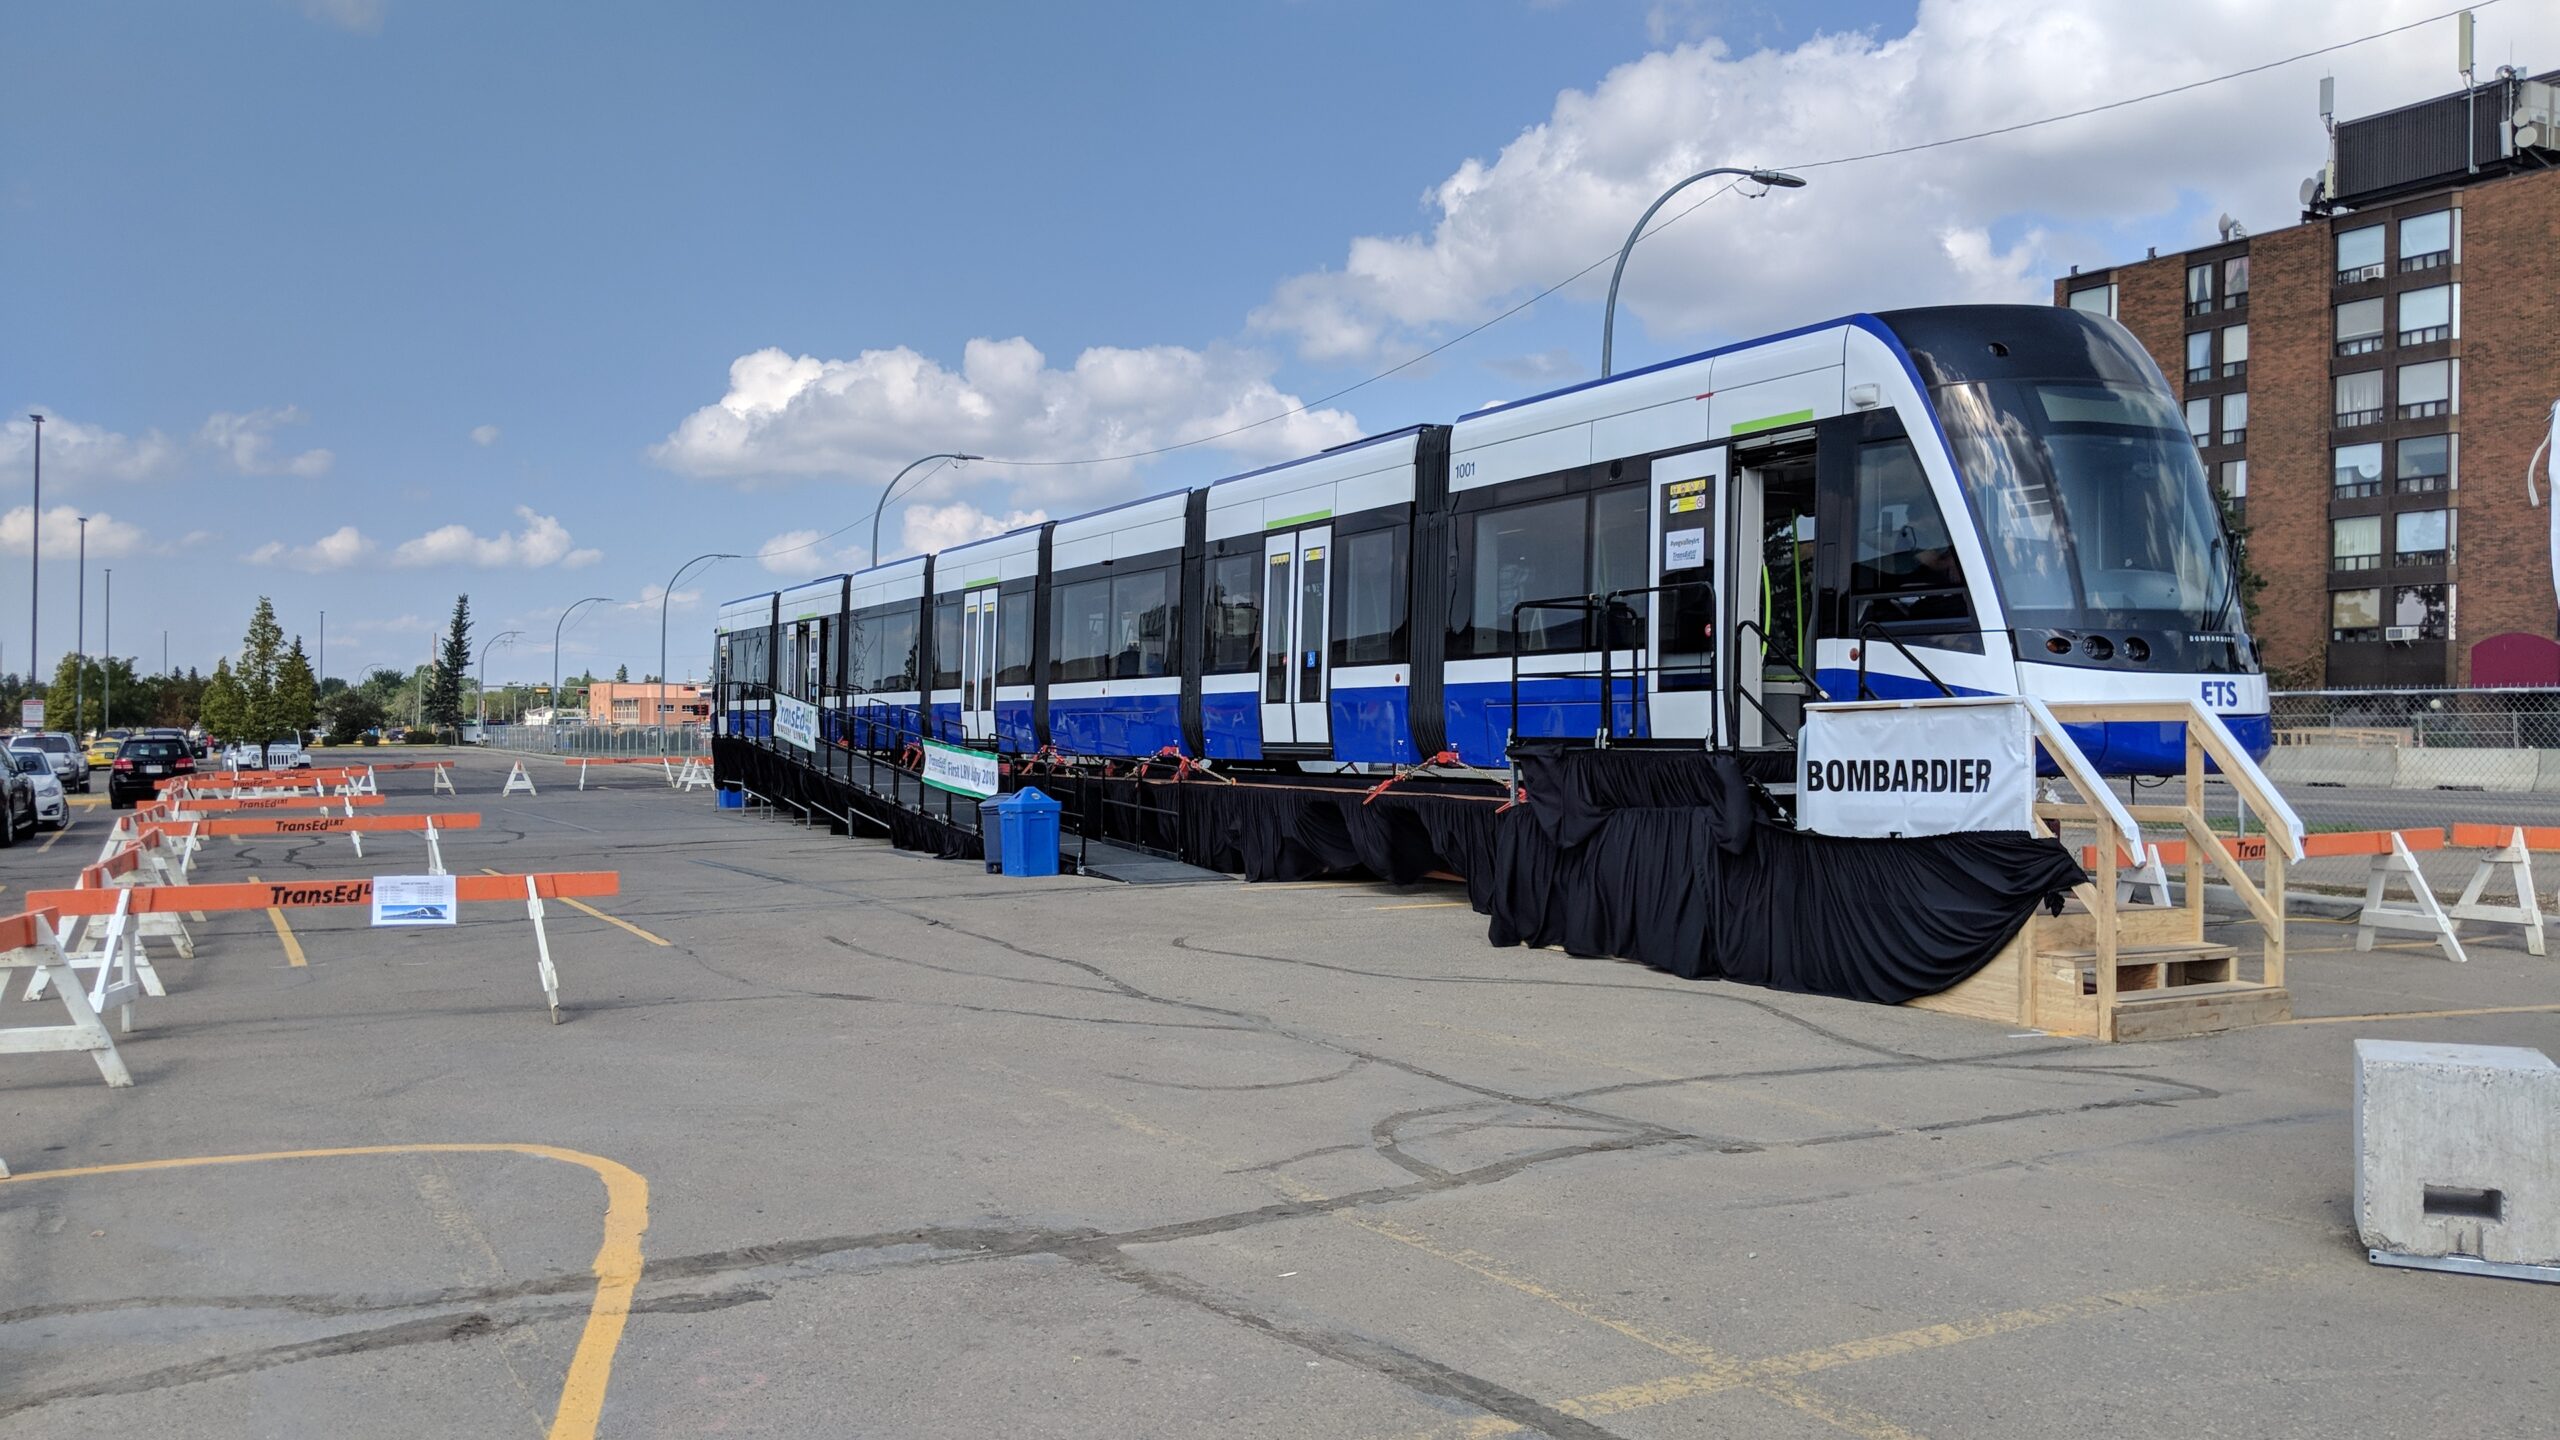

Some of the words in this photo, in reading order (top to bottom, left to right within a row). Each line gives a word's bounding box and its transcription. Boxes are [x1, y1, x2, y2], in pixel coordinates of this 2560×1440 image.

[1455, 461, 1475, 479] 1001
[2201, 681, 2238, 707] ETS
[982, 769, 996, 787] 2018
[1807, 759, 1992, 793] BOMBARDIER
[2237, 841, 2266, 858] Tran
